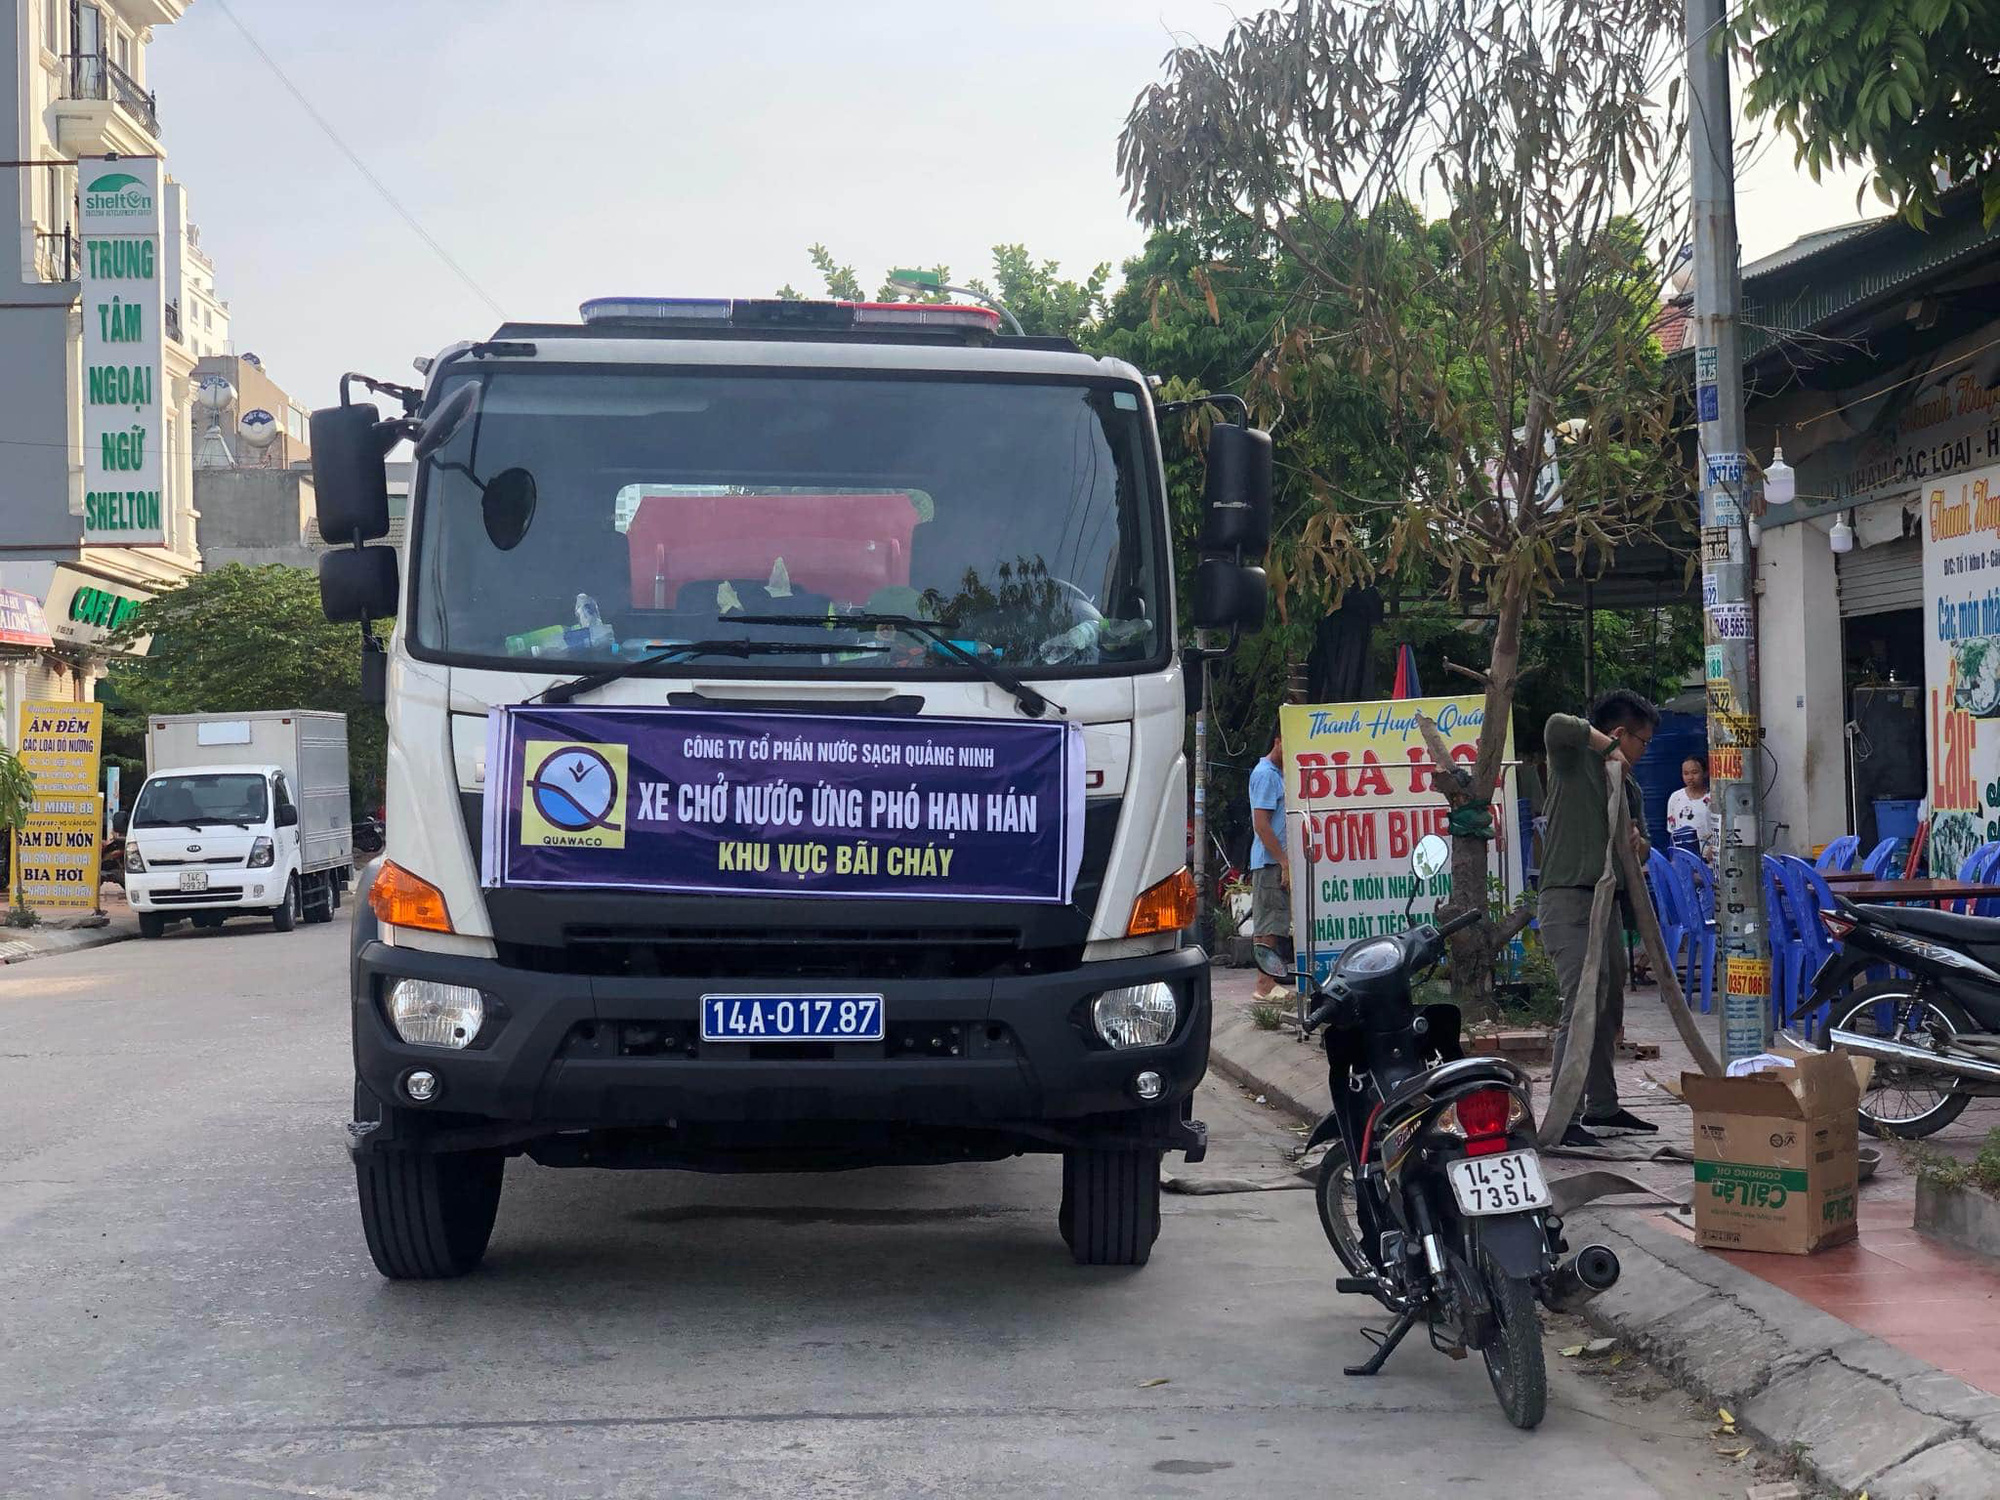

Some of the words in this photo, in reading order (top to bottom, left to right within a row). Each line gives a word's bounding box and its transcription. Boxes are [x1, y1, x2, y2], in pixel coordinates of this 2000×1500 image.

[87, 239, 154, 280] TRUNG
[98, 295, 142, 343] TÂM
[89, 366, 152, 413] NGOẠI
[102, 424, 146, 472] NGỮ
[86, 490, 161, 532] SHELTON
[1938, 594, 1956, 642] Các
[1959, 590, 1979, 639] món
[29, 716, 53, 733] ĂN
[56, 716, 90, 733] ĐÊM
[1308, 709, 1364, 740] Thanh
[23, 737, 37, 752] CÁC
[684, 735, 724, 760] CÔNG
[728, 738, 747, 760] TY
[749, 733, 771, 760] CỔ
[773, 735, 813, 762] PHẦN
[817, 740, 857, 763] NƯỚC
[862, 743, 901, 768] SẠCH
[905, 739, 954, 767] QUẢNG
[958, 747, 994, 768] NINH
[1296, 750, 1395, 800] BIA
[44, 801, 75, 814] MINH
[637, 782, 670, 821] XE
[678, 772, 729, 824] CHỞ
[735, 778, 804, 826] NƯỚC
[811, 780, 863, 828] ỨNG
[870, 783, 920, 830] PHÓ
[928, 791, 980, 839] HẠN
[987, 787, 1037, 833] HÁN
[66, 829, 94, 848] MÓN
[542, 835, 603, 847] QUAWACO
[1302, 808, 1378, 864] CƠM
[24, 868, 50, 881] BIA
[55, 868, 83, 882] HƠI
[718, 842, 770, 873] KHU
[778, 842, 828, 880] VỰC
[835, 840, 878, 876] BÃI
[887, 842, 954, 877] CHÁY
[1322, 875, 1349, 903] CÁC
[1352, 873, 1385, 901] MÓN
[1728, 974, 1747, 994] 0357
[713, 1001, 876, 1034] 14A-017.87
[1465, 1155, 1527, 1186] 14-S1
[1715, 1166, 1730, 1177] OIL
[1734, 1168, 1781, 1181] COOKING
[1470, 1181, 1537, 1211] 7354
